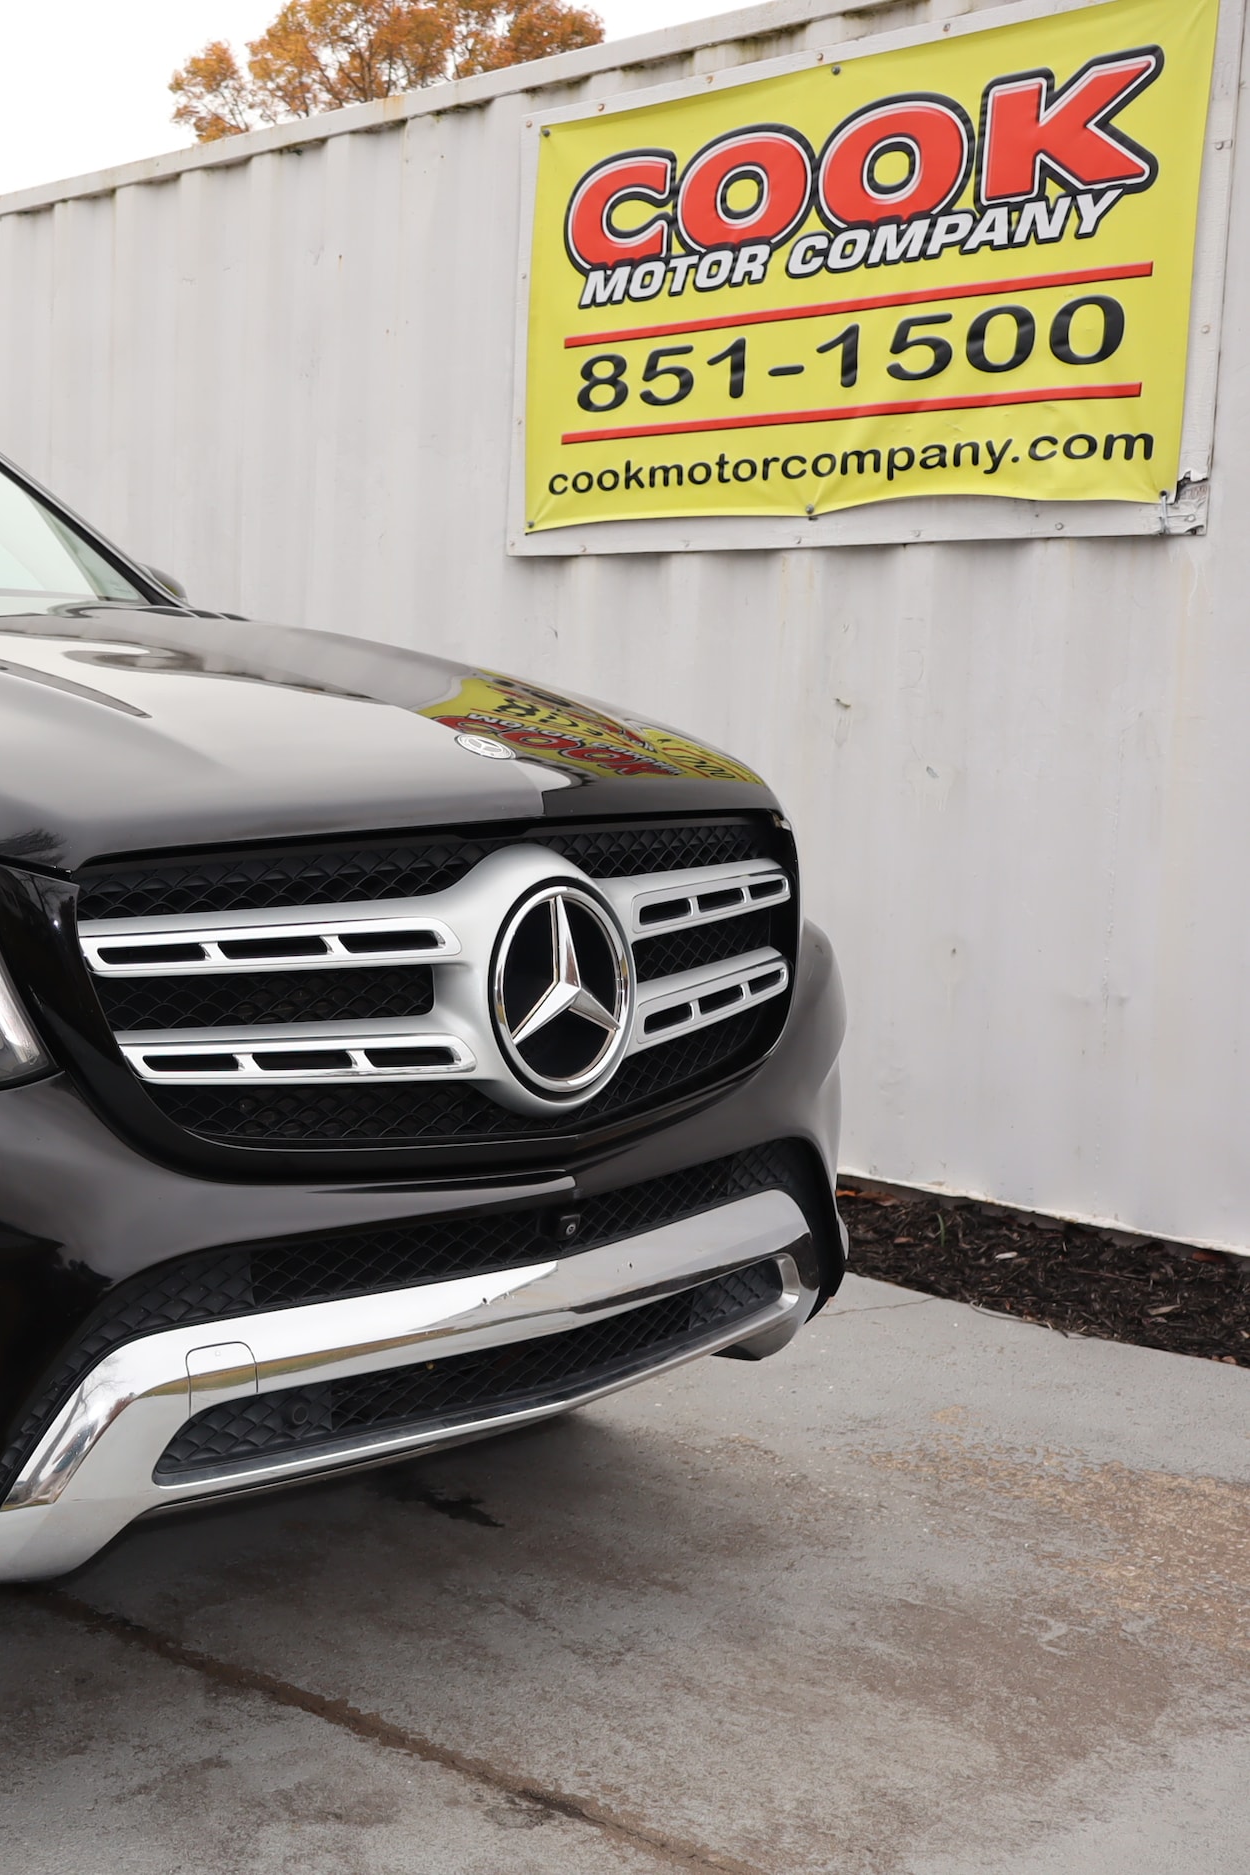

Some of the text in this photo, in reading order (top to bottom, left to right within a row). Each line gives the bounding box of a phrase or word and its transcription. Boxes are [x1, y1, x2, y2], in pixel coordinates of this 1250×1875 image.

[564, 45, 1164, 278] COOK
[578, 186, 1124, 309] MOTOR COMPANY
[577, 295, 1125, 413] 851-1500
[548, 431, 1154, 496] cookmotorcompany.com
